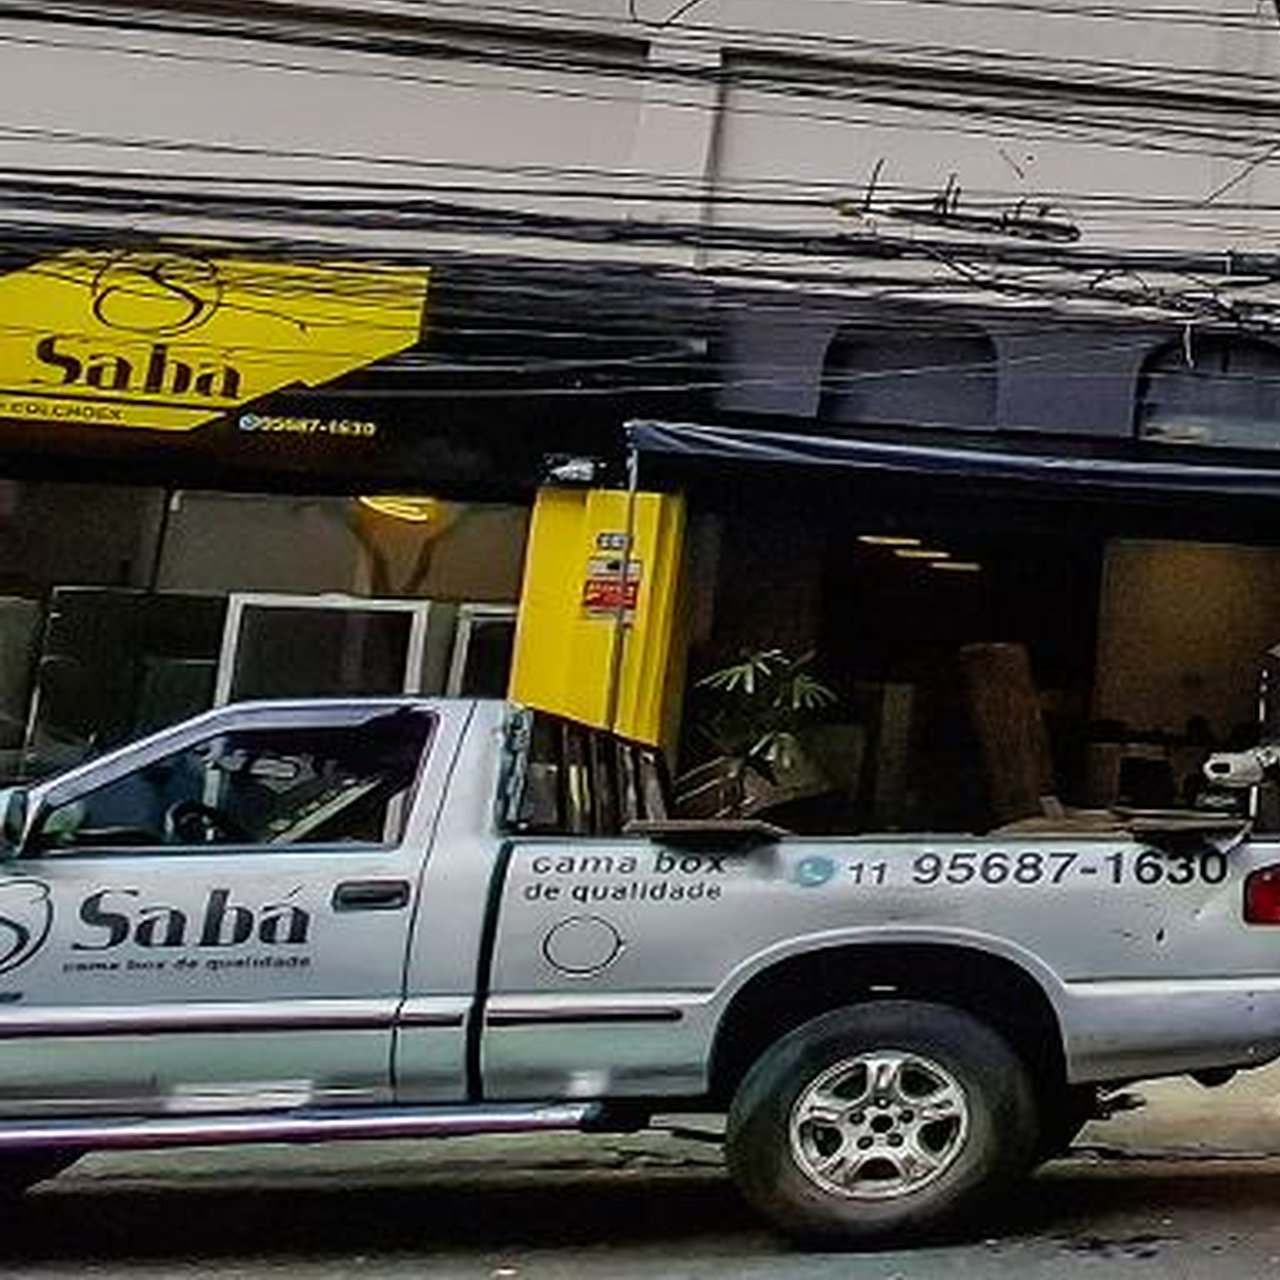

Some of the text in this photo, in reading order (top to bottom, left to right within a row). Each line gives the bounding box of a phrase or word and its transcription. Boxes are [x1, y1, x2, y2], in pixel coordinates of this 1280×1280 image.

[532, 850, 728, 874] cama box
[850, 850, 1228, 885] 11 95687-1630
[524, 881, 722, 902] de qualidade
[71, 885, 311, 951] Sabá
